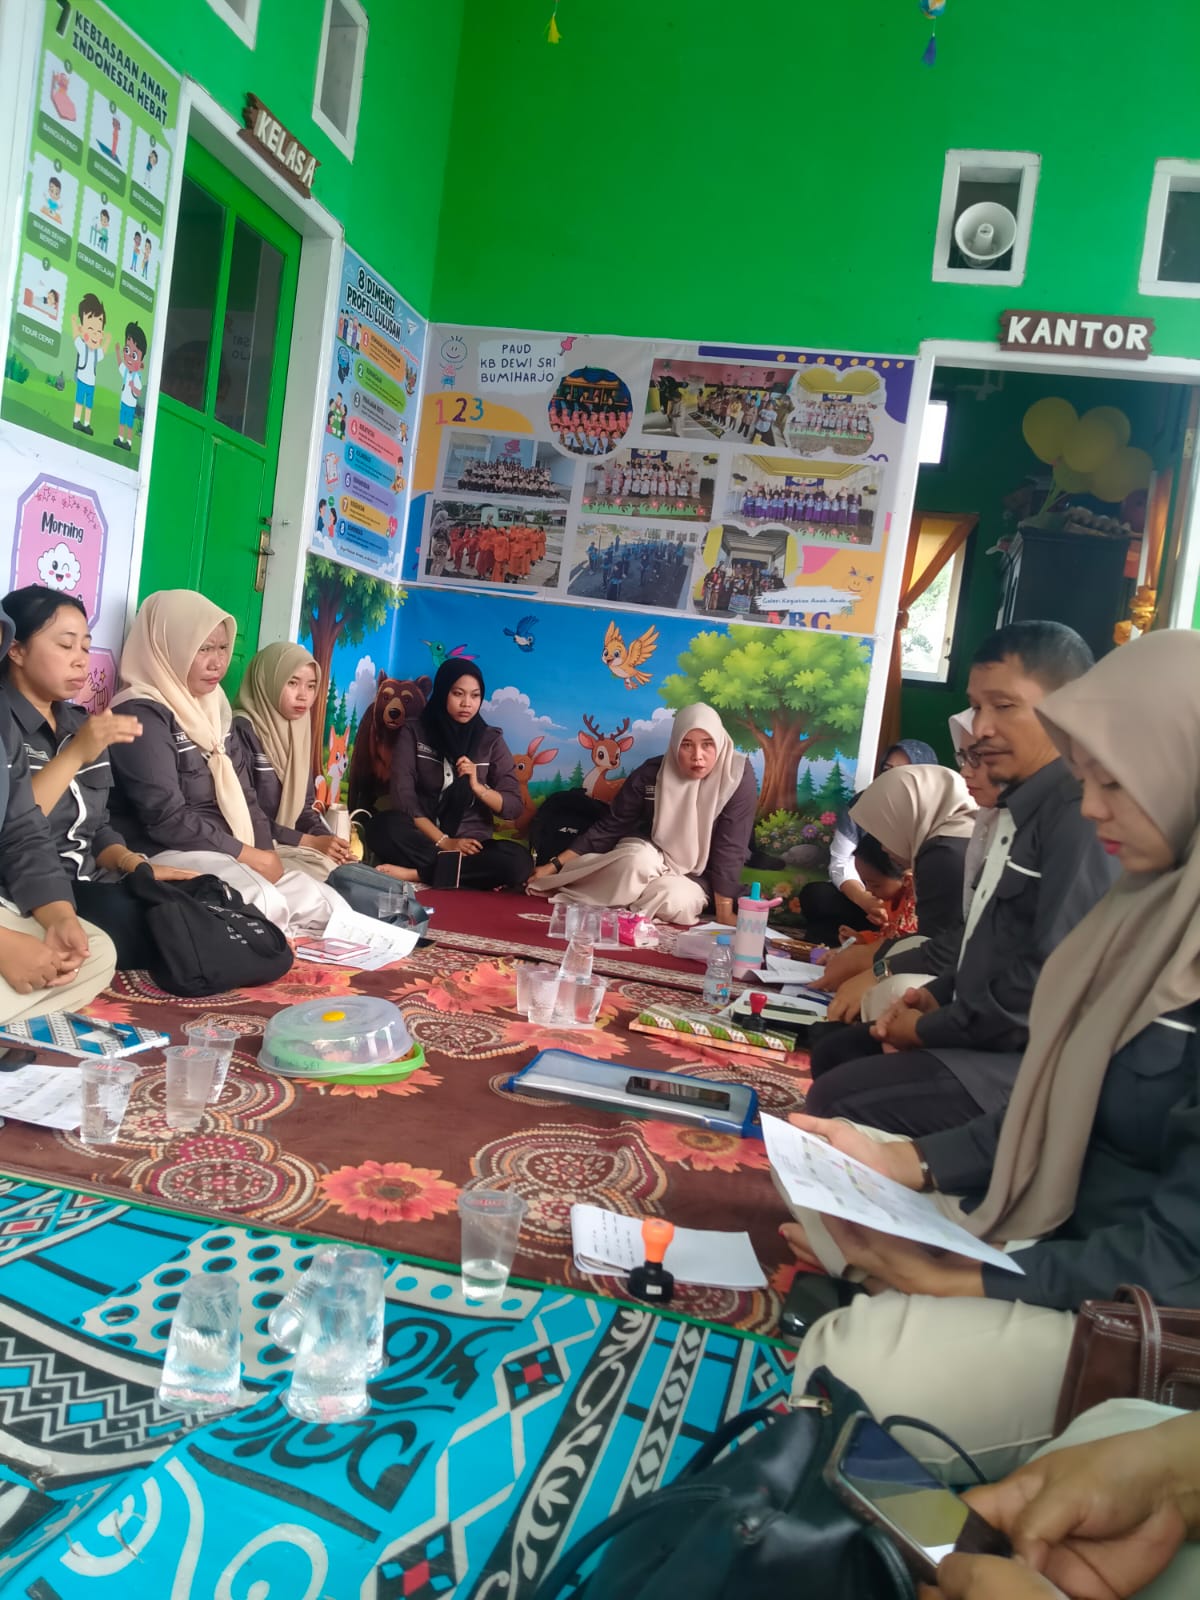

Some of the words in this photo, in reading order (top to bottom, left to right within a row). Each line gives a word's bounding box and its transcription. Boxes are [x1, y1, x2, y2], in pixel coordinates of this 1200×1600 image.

[75, 10, 139, 80] KEBIASAAN
[141, 71, 168, 106] ANAK
[72, 31, 135, 98] INDONESIA
[137, 88, 167, 126] HEBAT
[358, 268, 366, 290] 8
[367, 277, 395, 314] DIMENSI
[347, 285, 373, 319] PROFIL
[374, 306, 401, 341] LULUSAN
[501, 343, 532, 355] PAUD
[1007, 315, 1148, 350] KANTOR
[480, 358, 496, 369] KB
[501, 357, 533, 369] DEWI
[537, 356, 556, 368] SRI
[480, 371, 555, 383] BUMIHARJO
[41, 511, 84, 543] Morning
